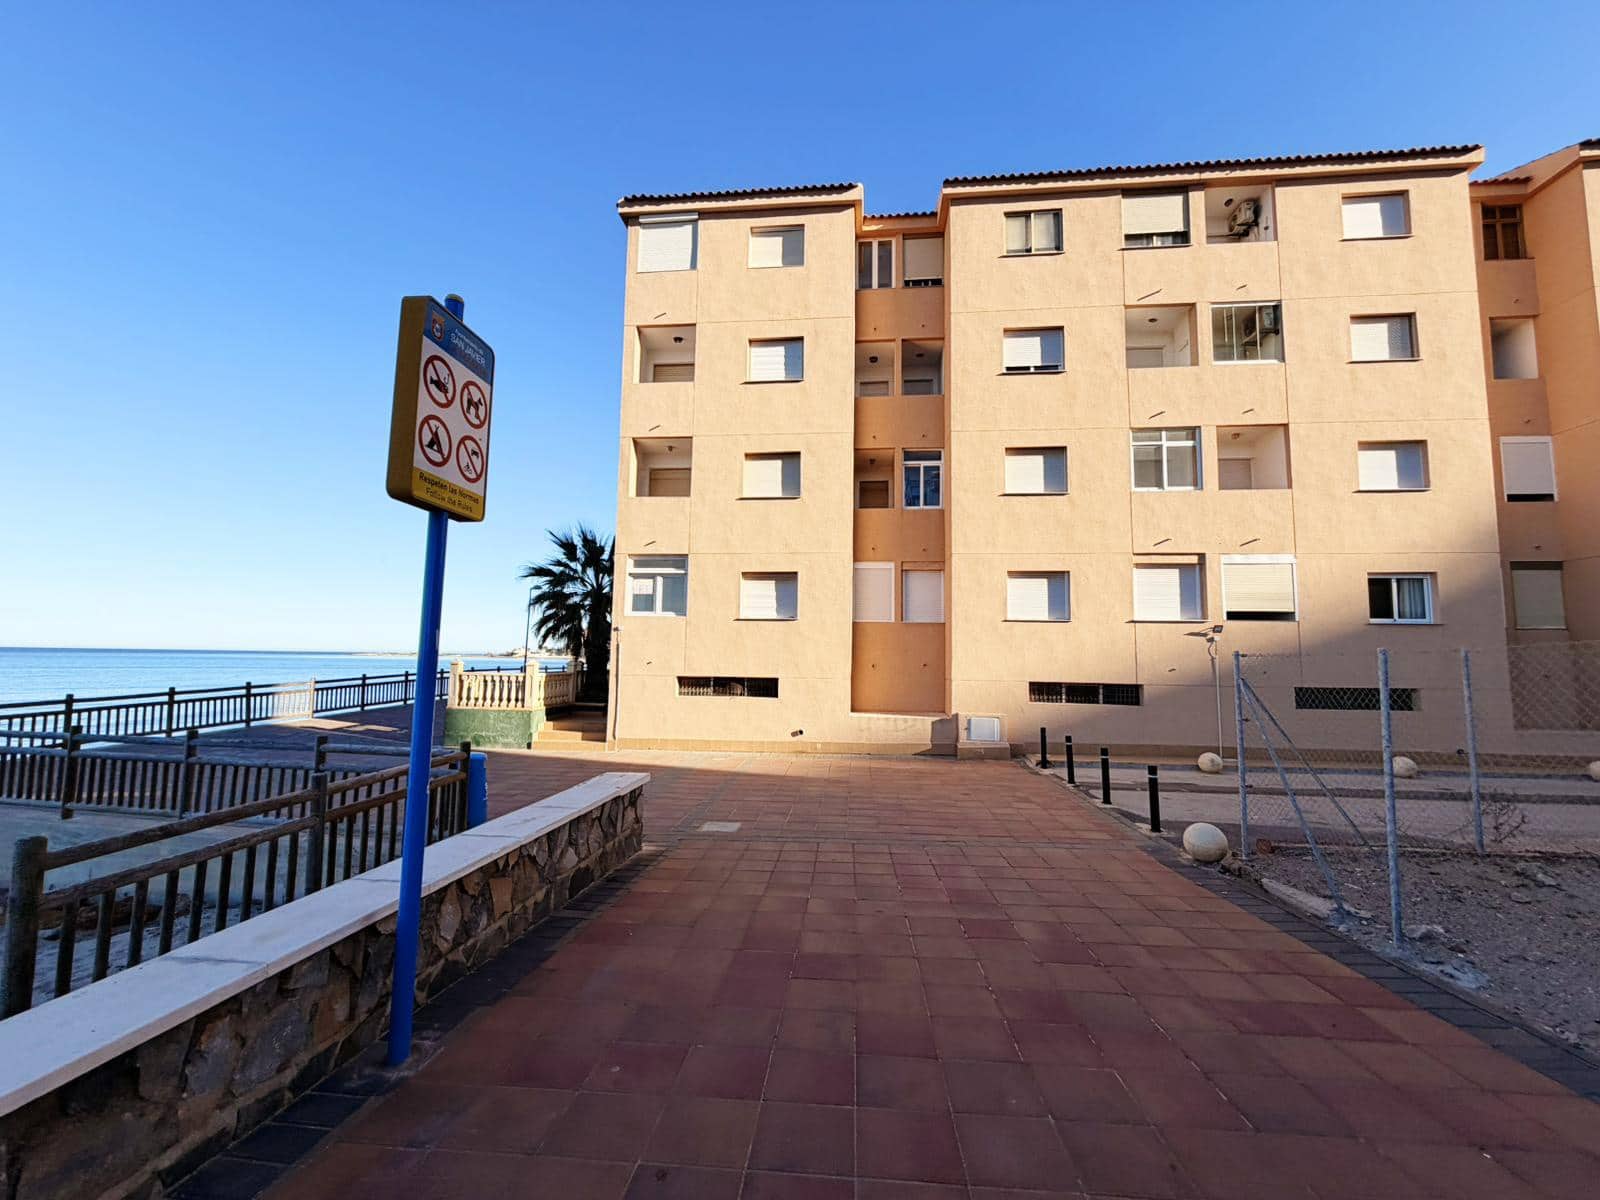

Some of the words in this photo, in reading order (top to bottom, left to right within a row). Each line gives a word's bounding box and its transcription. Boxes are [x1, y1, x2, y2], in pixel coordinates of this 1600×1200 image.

[450, 333, 464, 350] SAN
[464, 345, 486, 367] JAVIER
[419, 472, 448, 490] Respeten
[459, 489, 480, 504] Normas
